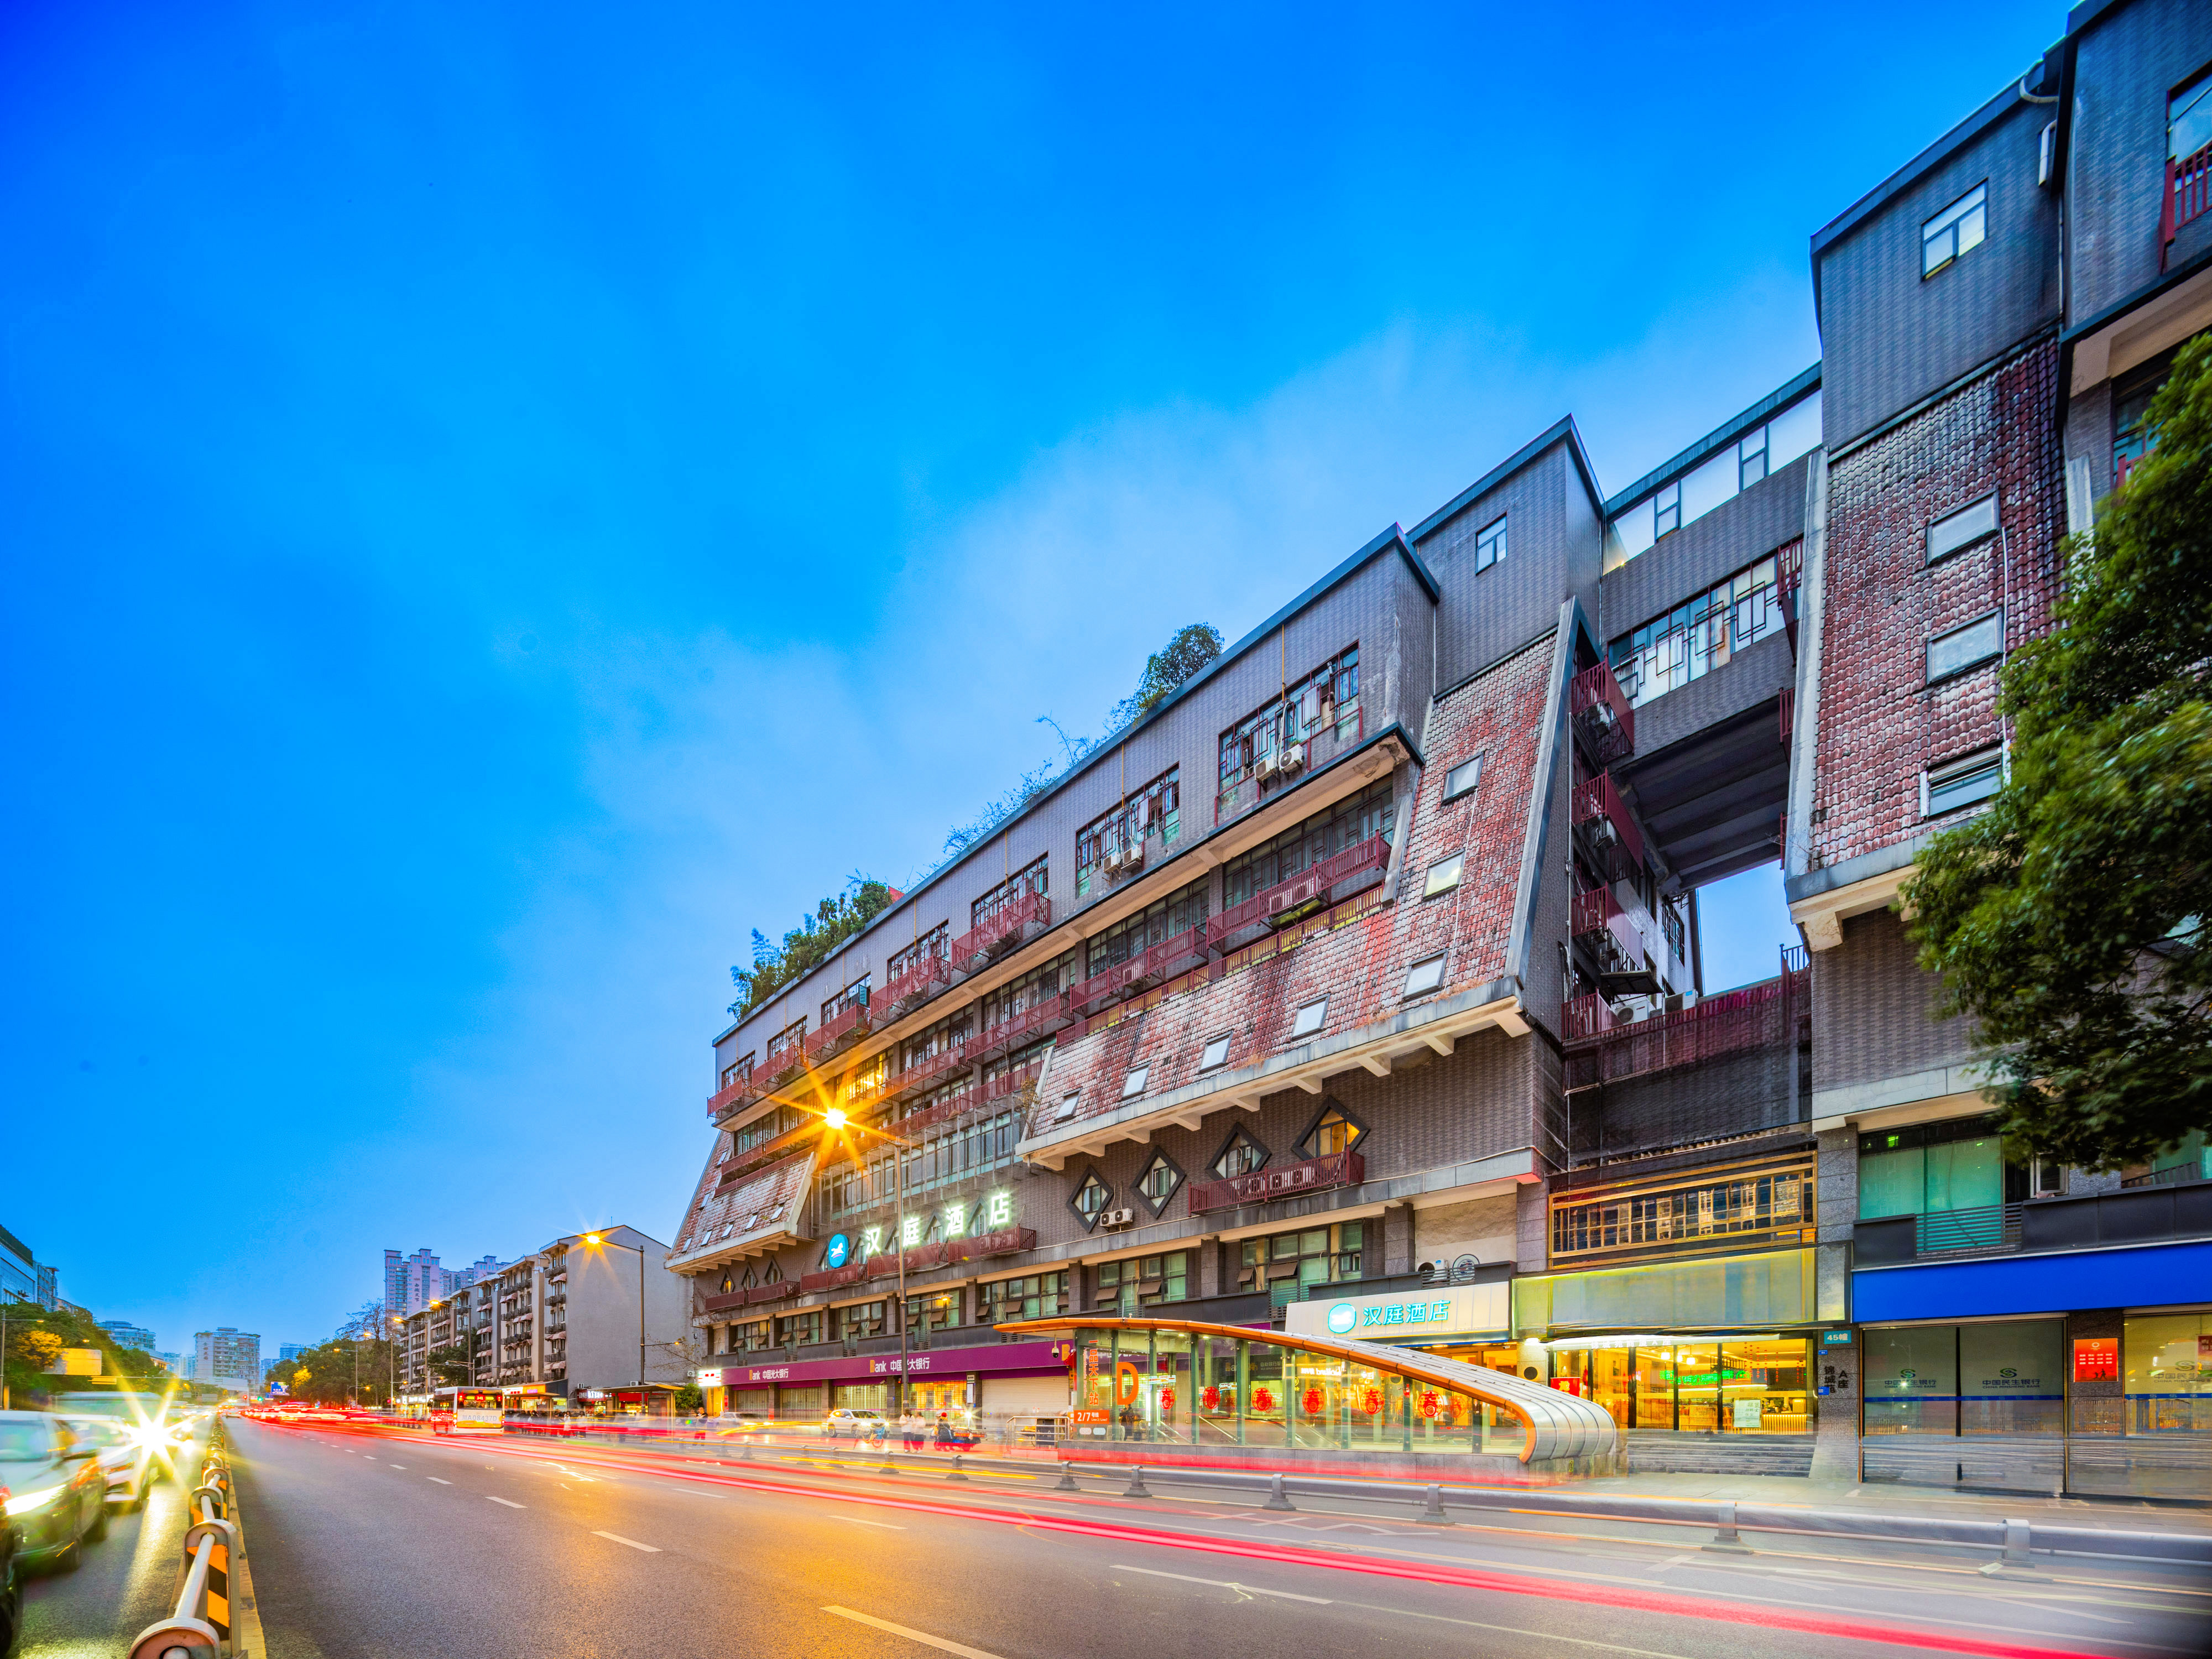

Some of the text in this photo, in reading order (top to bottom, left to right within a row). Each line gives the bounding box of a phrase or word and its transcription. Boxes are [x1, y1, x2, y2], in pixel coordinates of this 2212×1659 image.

[865, 1192, 1010, 1255] 汉庭酒店
[1362, 1300, 1451, 1327] 汉庭酒店
[749, 1370, 760, 1380] Bank
[763, 1368, 789, 1379] 中国光大银行
[870, 1360, 886, 1373] Bank
[1088, 1339, 1099, 1406] 一品天下站
[1117, 1362, 1139, 1405] D
[1838, 1370, 1849, 1388] A座
[1077, 1412, 1091, 1422] 2/7
